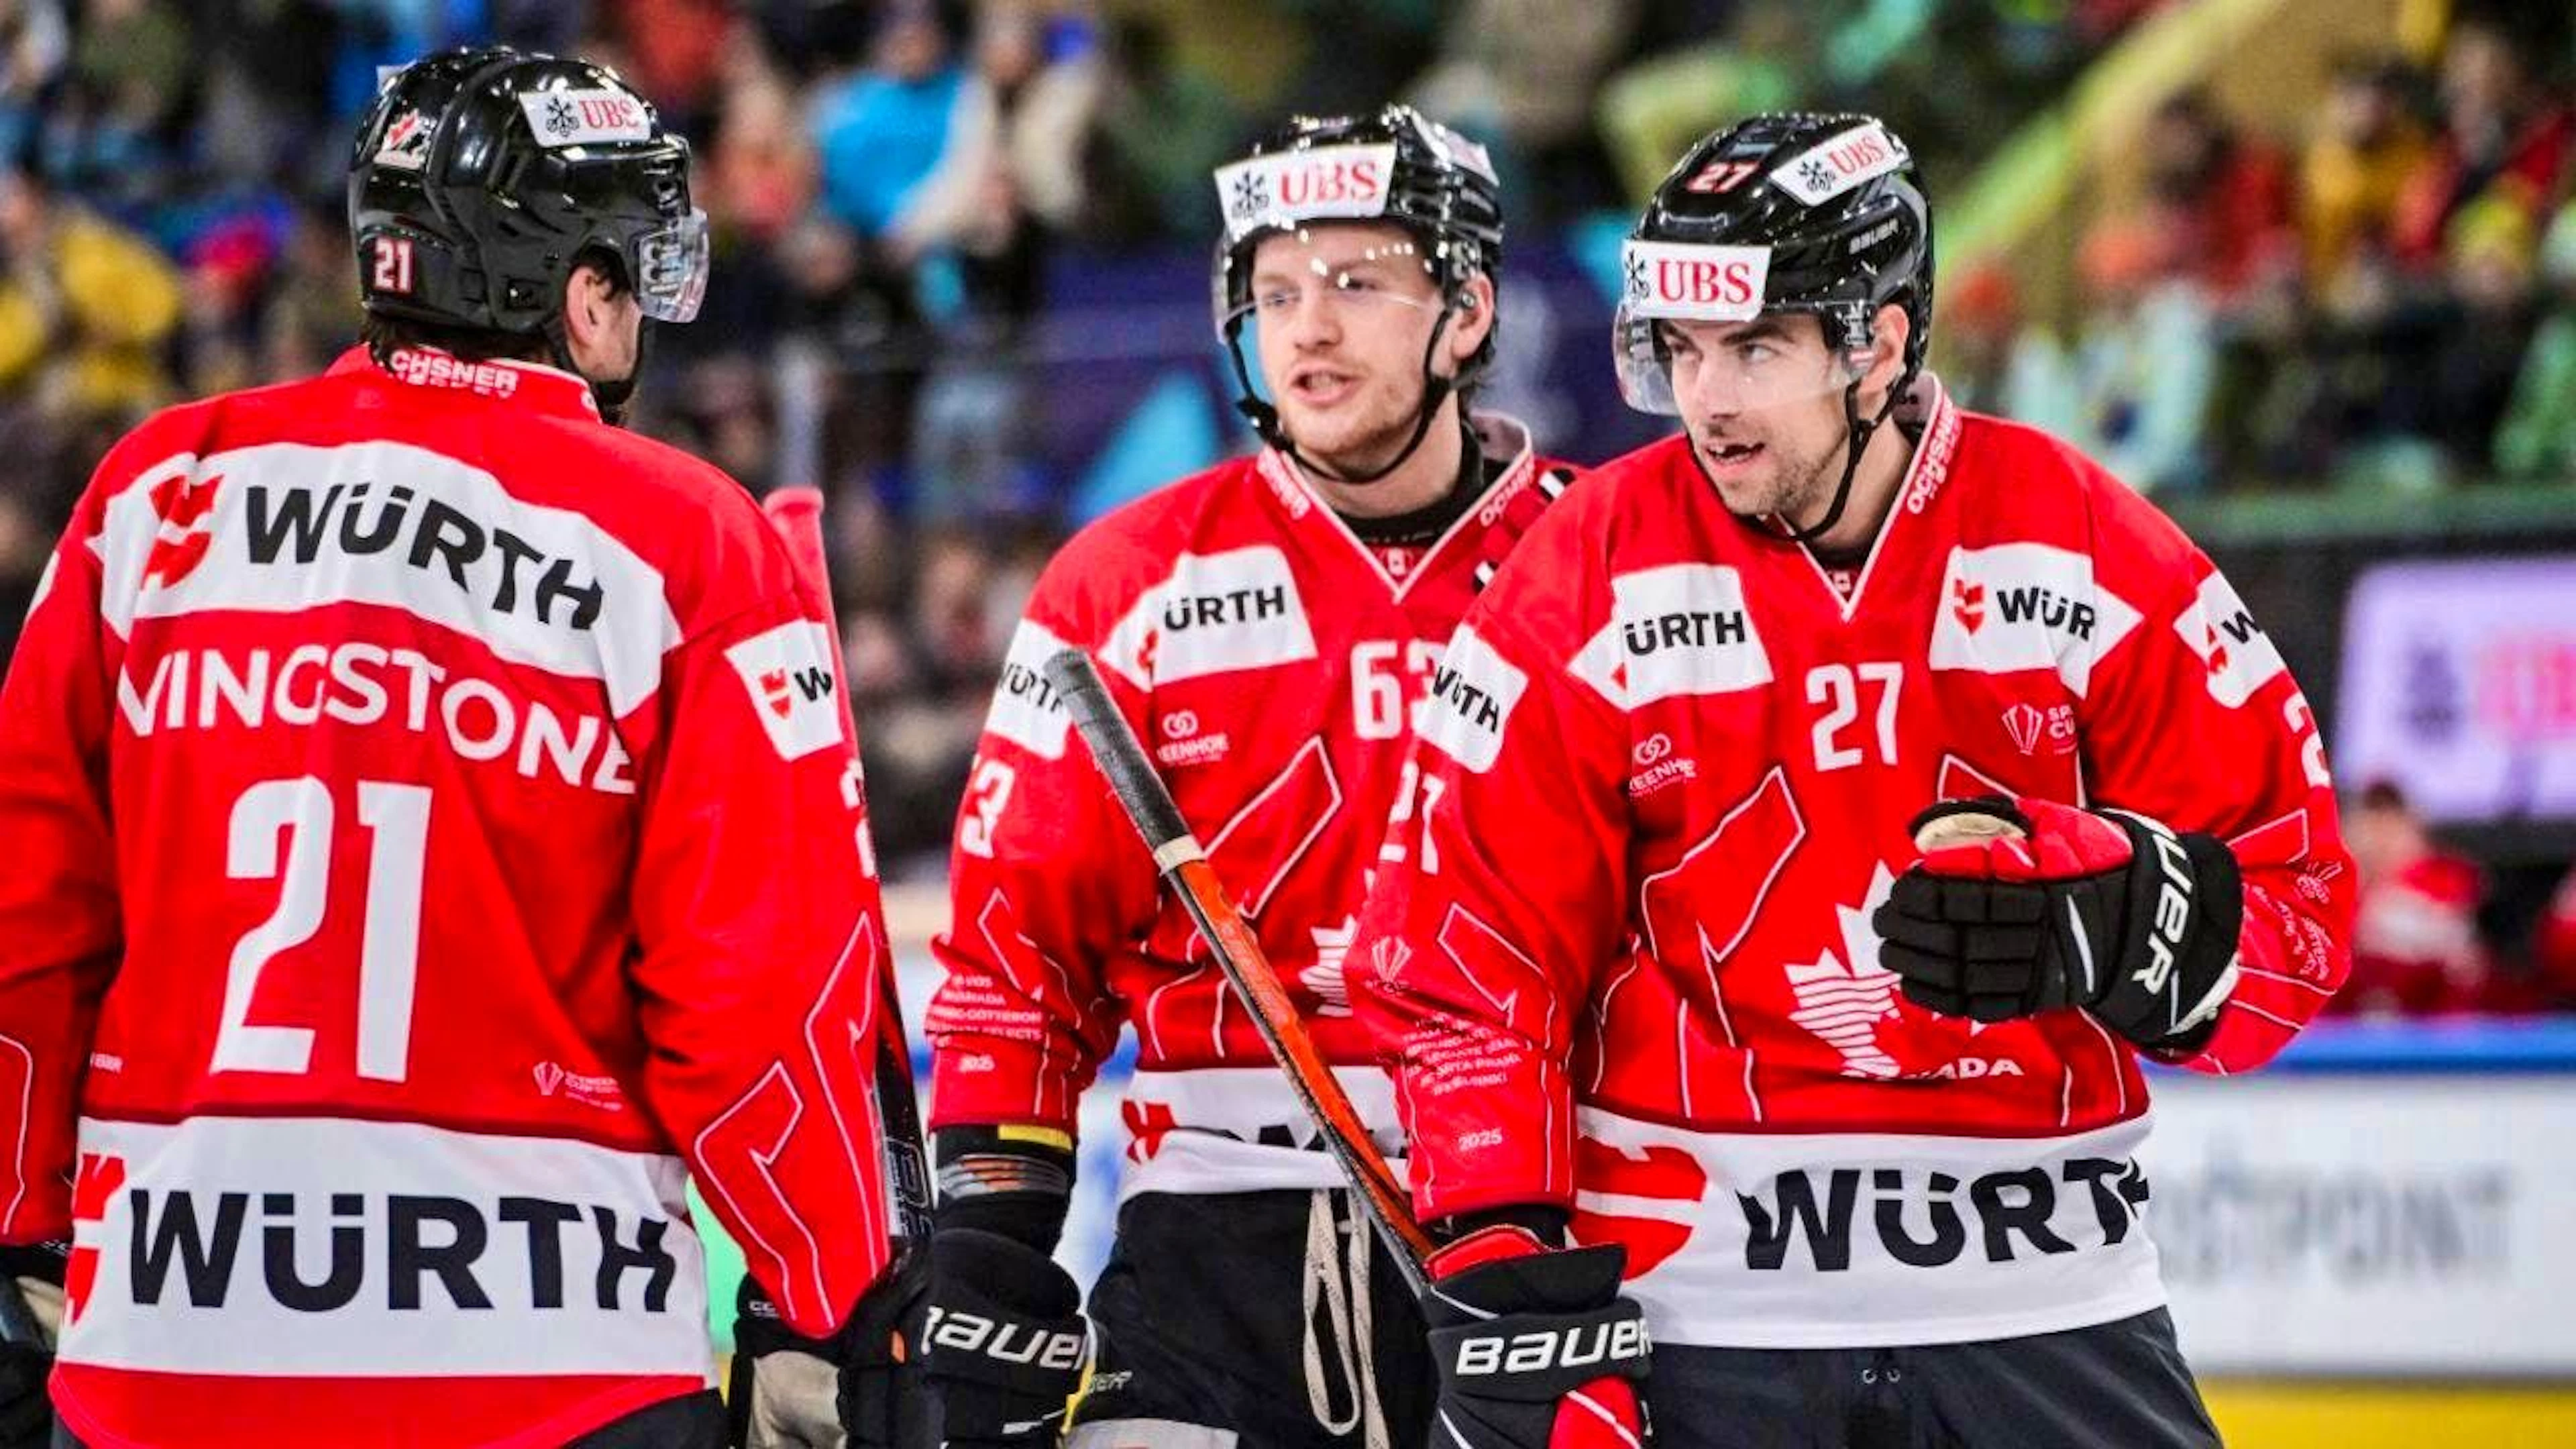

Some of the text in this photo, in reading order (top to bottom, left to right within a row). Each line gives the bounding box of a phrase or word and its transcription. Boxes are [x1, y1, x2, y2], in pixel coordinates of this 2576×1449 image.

[579, 99, 641, 129] UBS
[1686, 161, 1759, 193] 27
[1828, 136, 1884, 174] UBS
[1279, 160, 1378, 207] UBS
[375, 237, 411, 293] 21
[1657, 260, 1752, 305] UBS
[388, 349, 519, 392] CHSNER
[246, 482, 604, 631] WÜRTH
[1165, 586, 1285, 631] ÜRTH
[1623, 610, 1746, 656] ÜRTH
[1996, 586, 2096, 641] WÜR
[1806, 662, 1903, 773] 27
[961, 754, 1016, 859] 3
[209, 773, 433, 1083] 21
[129, 1187, 677, 1313] WÜRTH
[1456, 1318, 1654, 1376] BAUER
